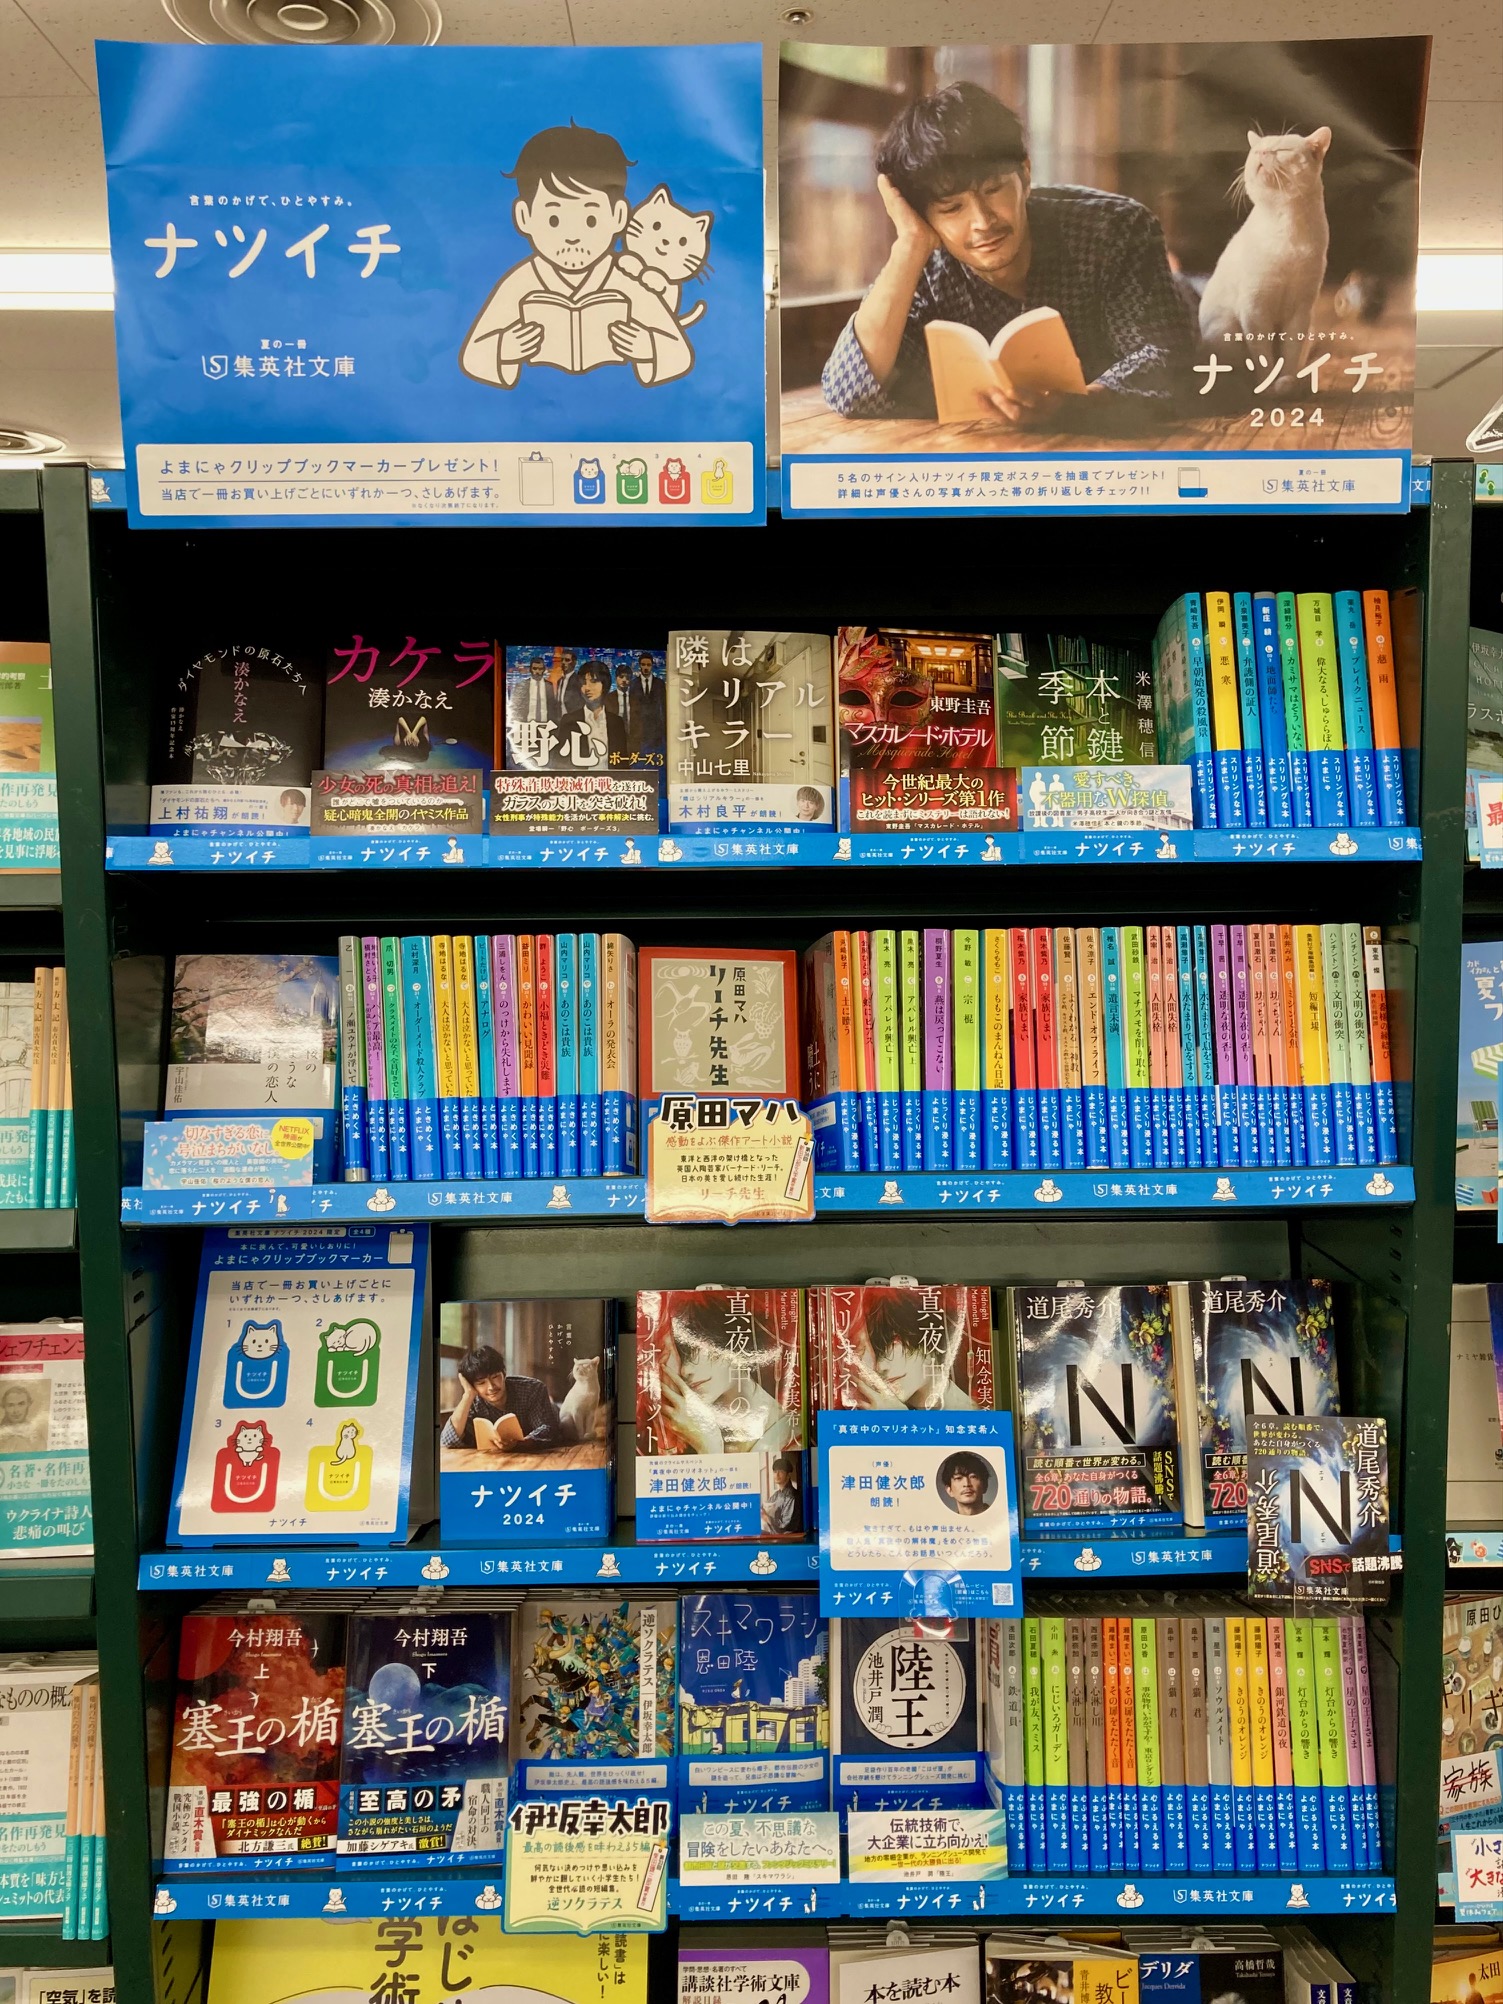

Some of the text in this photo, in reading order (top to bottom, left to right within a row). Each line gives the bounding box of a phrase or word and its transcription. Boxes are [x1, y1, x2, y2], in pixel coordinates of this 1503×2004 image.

[144, 222, 402, 279] ナツイチ
[260, 338, 307, 350] 夏の一冊
[233, 354, 356, 378] 集英社文庫
[1192, 351, 1385, 395] ナツイチ
[1249, 407, 1325, 428] 2024
[1280, 479, 1356, 493] 集英社文庫
[327, 634, 495, 689] カケラ
[674, 635, 753, 669] 隣は
[232, 660, 250, 724] 湊かなえ
[368, 687, 453, 711] 湊かなえ
[679, 677, 826, 709] シリアル
[1193, 656, 1208, 738] 早朝始発の殺風景
[1243, 657, 1257, 717] 弁護側の証人
[1266, 665, 1279, 715] 地面師たち
[1351, 656, 1366, 734] ブレイクニュース
[928, 697, 992, 716] 東野圭吾
[1135, 670, 1155, 758] 米澤穂信
[1287, 656, 1303, 750] カミサマはそういない
[511, 720, 608, 768] 野心
[677, 720, 793, 751] キラー
[844, 720, 993, 748] マスカレード・ホテル
[609, 752, 664, 767] ボーダーズ3
[677, 758, 751, 777] 中山七里
[882, 773, 984, 791] 今世紀最大の
[1072, 769, 1141, 788] 愛すべき、
[1230, 757, 1242, 818] スリリングな本
[1279, 757, 1290, 818] スリリングな本
[1333, 757, 1345, 818] スリリングな本
[861, 790, 1005, 807] ヒット・シリーズ第1作
[324, 808, 469, 822] 疑心暗鬼全開のイヤミス作品
[211, 850, 276, 864] ナツイチ
[360, 846, 431, 863] ナツイチ
[540, 847, 609, 863] ナツイチ
[731, 843, 799, 855] 集英社文庫
[900, 844, 969, 859] ナツイチ
[1075, 841, 1144, 857] ナツイチ
[1232, 842, 1296, 857] ナツイチ
[732, 966, 748, 1025] 原田マハ
[480, 1001, 491, 1039] アナログ
[709, 964, 729, 1087] リーチ先生
[1018, 993, 1029, 1041] 家族じまい
[1041, 993, 1052, 1041] 家族じまい
[1151, 993, 1162, 1033] 人間失格
[1167, 993, 1178, 1033] 人間失格
[1254, 990, 1266, 1037] 坊っちゃん
[522, 1000, 535, 1070] かわいい見聞録
[560, 1000, 572, 1058] あのこは貴族
[582, 1000, 594, 1058] あのこは貴族
[606, 1000, 617, 1069] オーラの発表会
[934, 995, 946, 1073] 燕は戻ってこない
[499, 1000, 512, 1097] のっけから失礼します
[661, 1095, 800, 1131] 原田マハ
[278, 1125, 310, 1135] NETFLIX
[665, 1135, 793, 1148] 感動をよぶ傑作アート小説
[444, 1190, 514, 1205] 集英社文庫
[701, 1187, 766, 1200] リーチ先生
[1110, 1182, 1179, 1197] 集英社文庫
[191, 1199, 261, 1216] ナツイチ
[214, 1253, 384, 1265] よまにゃクリップブックマーカー
[231, 1279, 391, 1291] 当店で一冊お買い上げごとに
[229, 1293, 386, 1304] いずれか一つ、さしあげます。
[790, 1292, 798, 1323] Midnight
[980, 1288, 988, 1321] Midnight
[1026, 1295, 1118, 1320] 道尾秀介
[1200, 1288, 1287, 1313] 道尾秀介
[315, 1318, 323, 1327] 2
[724, 1291, 753, 1418] 真夜中の
[1066, 1363, 1136, 1446] N
[215, 1419, 222, 1428] 3
[306, 1418, 314, 1427] 4
[945, 1424, 999, 1435] 知念実希人
[1253, 1440, 1321, 1448] あなた自身がつくる
[1033, 1456, 1142, 1468] 読む順番で世界が変わる。
[1356, 1422, 1382, 1528] 道尾秀介
[841, 1475, 926, 1491] 津田健次郎
[6, 1504, 93, 1523] ウクライナ詩人
[502, 1513, 545, 1526] 2024
[1289, 1469, 1353, 1545] N
[12, 1522, 86, 1541] 悲痛の叫び
[1255, 1468, 1280, 1575] 道尾秀介
[167, 1564, 234, 1578] 集英社文庫
[497, 1559, 564, 1573] 集英社文庫
[227, 1628, 303, 1648] 今村翔吾
[393, 1627, 468, 1648] 今村翔吾
[691, 1603, 818, 1647] スキマワラシ
[641, 1613, 656, 1687] 逆ソクラテス
[695, 1648, 759, 1675] 恩田陸
[253, 1663, 270, 1679] 上
[421, 1663, 437, 1680] 下
[867, 1651, 885, 1724] 池井戸潤
[887, 1642, 936, 1740] 陸王
[176, 1694, 341, 1757] 塞王の楯
[347, 1693, 508, 1756] 塞王の楯
[641, 1699, 654, 1754] 伊坂幸太郎
[1109, 1686, 1119, 1768] その扉をたたく音
[1234, 1686, 1248, 1761] きのうのオレンジ
[1256, 1686, 1268, 1761] きのうのオレンジ
[1274, 1686, 1288, 1749] 銀河鉄道の夜
[1443, 1758, 1494, 1803] 家族
[211, 1787, 315, 1813] 最強の楯
[359, 1786, 462, 1812] 至高の矛
[510, 1799, 668, 1836] 伊坂幸太郎
[703, 1819, 816, 1838] この夏、不思議な
[889, 1817, 965, 1833] 伝統技術で、
[226, 1826, 302, 1838] ダイナミックなんだ
[523, 1840, 651, 1854] 最高の読後感を味わえる5編
[686, 1841, 834, 1858] 冒険をしたいあなたへ。
[547, 1896, 623, 1911] 逆ソクラテス
[1140, 1960, 1195, 1979] デリダ
[1234, 1959, 1276, 1971] 高橋哲哉
[681, 1974, 801, 1993] 講談社学術文庫
[863, 1972, 961, 2004] 本を読む本
